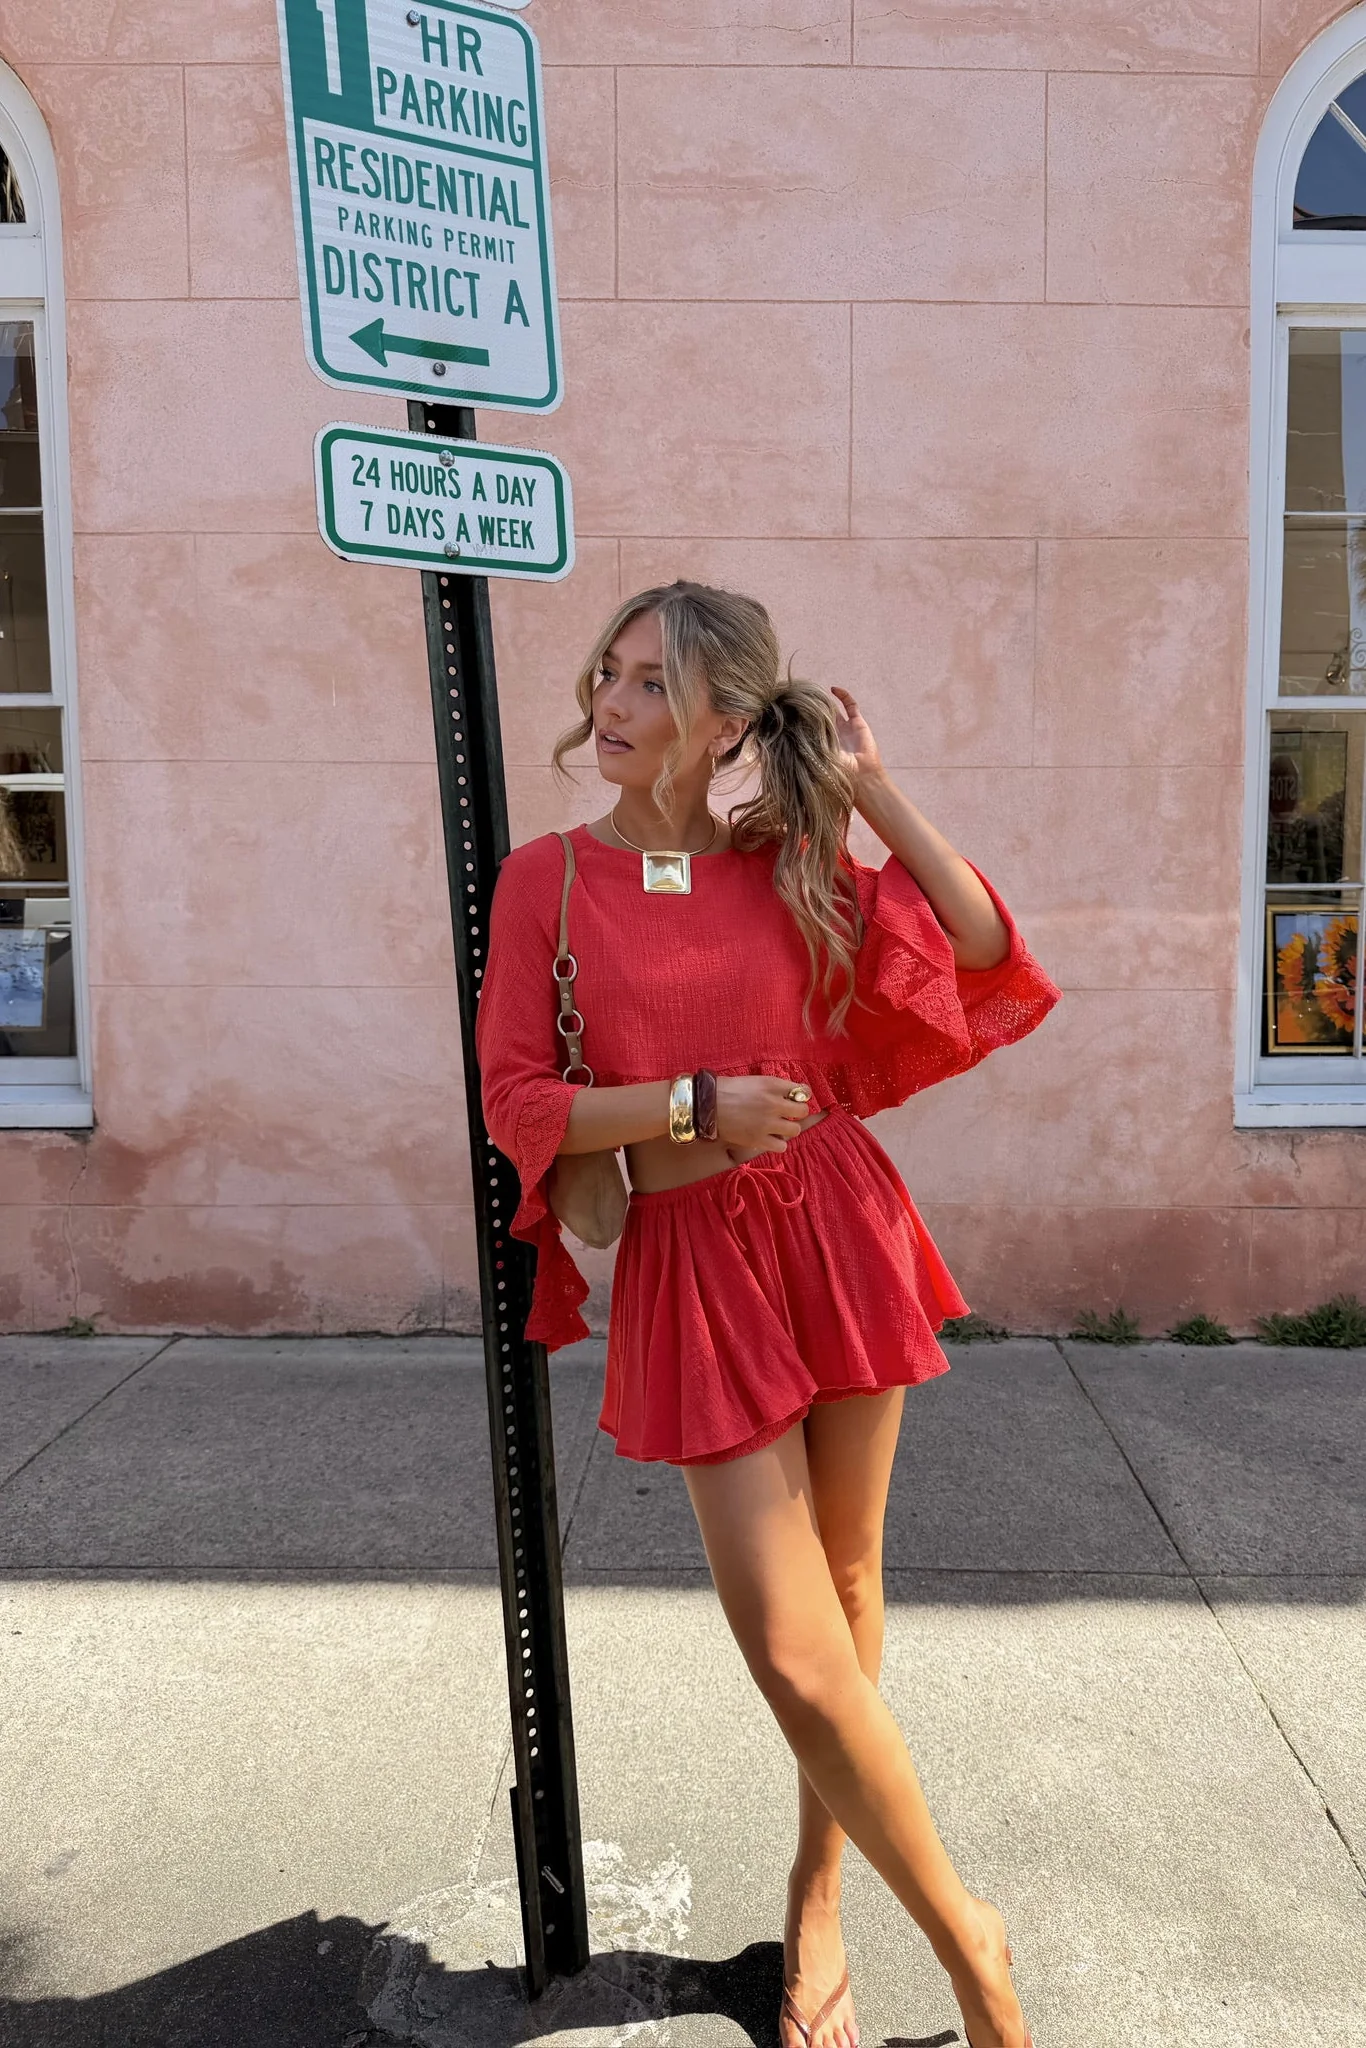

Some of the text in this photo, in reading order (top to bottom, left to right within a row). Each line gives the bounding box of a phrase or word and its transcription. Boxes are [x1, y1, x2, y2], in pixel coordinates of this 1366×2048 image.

[316, 0, 484, 96] 1 HR
[376, 66, 528, 148] PARKING
[313, 136, 530, 230] RESIDENTIAL
[337, 205, 516, 265] PARKING PERMIT
[322, 244, 531, 328] DISTRICT A
[351, 454, 537, 508] 24 HOURS A DAY
[359, 499, 374, 532] 7
[386, 503, 446, 541] DAYS
[455, 512, 471, 544] A
[477, 514, 536, 551] WEEK
